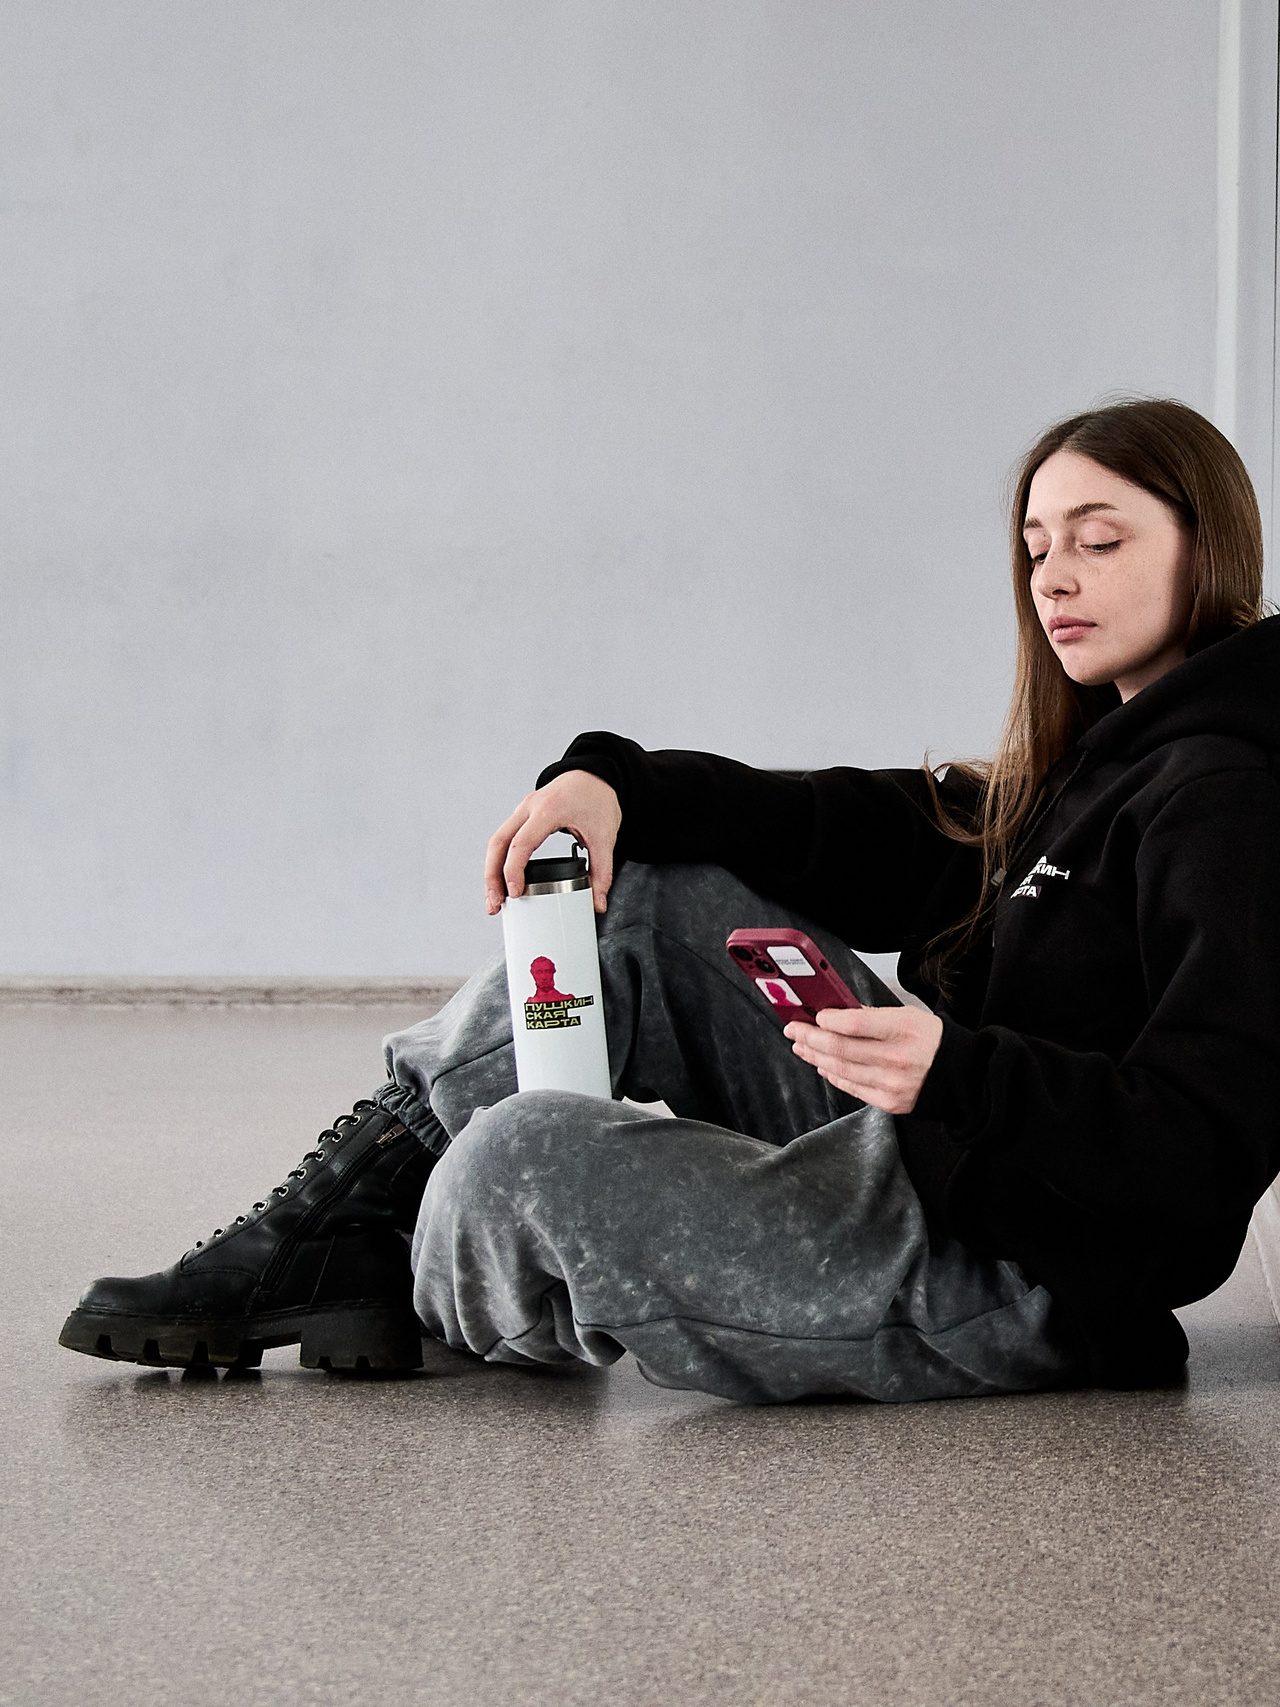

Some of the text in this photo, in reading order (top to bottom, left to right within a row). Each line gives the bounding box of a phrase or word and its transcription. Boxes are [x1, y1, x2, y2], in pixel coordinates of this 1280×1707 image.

[525, 997, 593, 1012] ПУШКИН
[526, 1010, 566, 1020] СКАЯ
[527, 1018, 579, 1029] КАРТА
